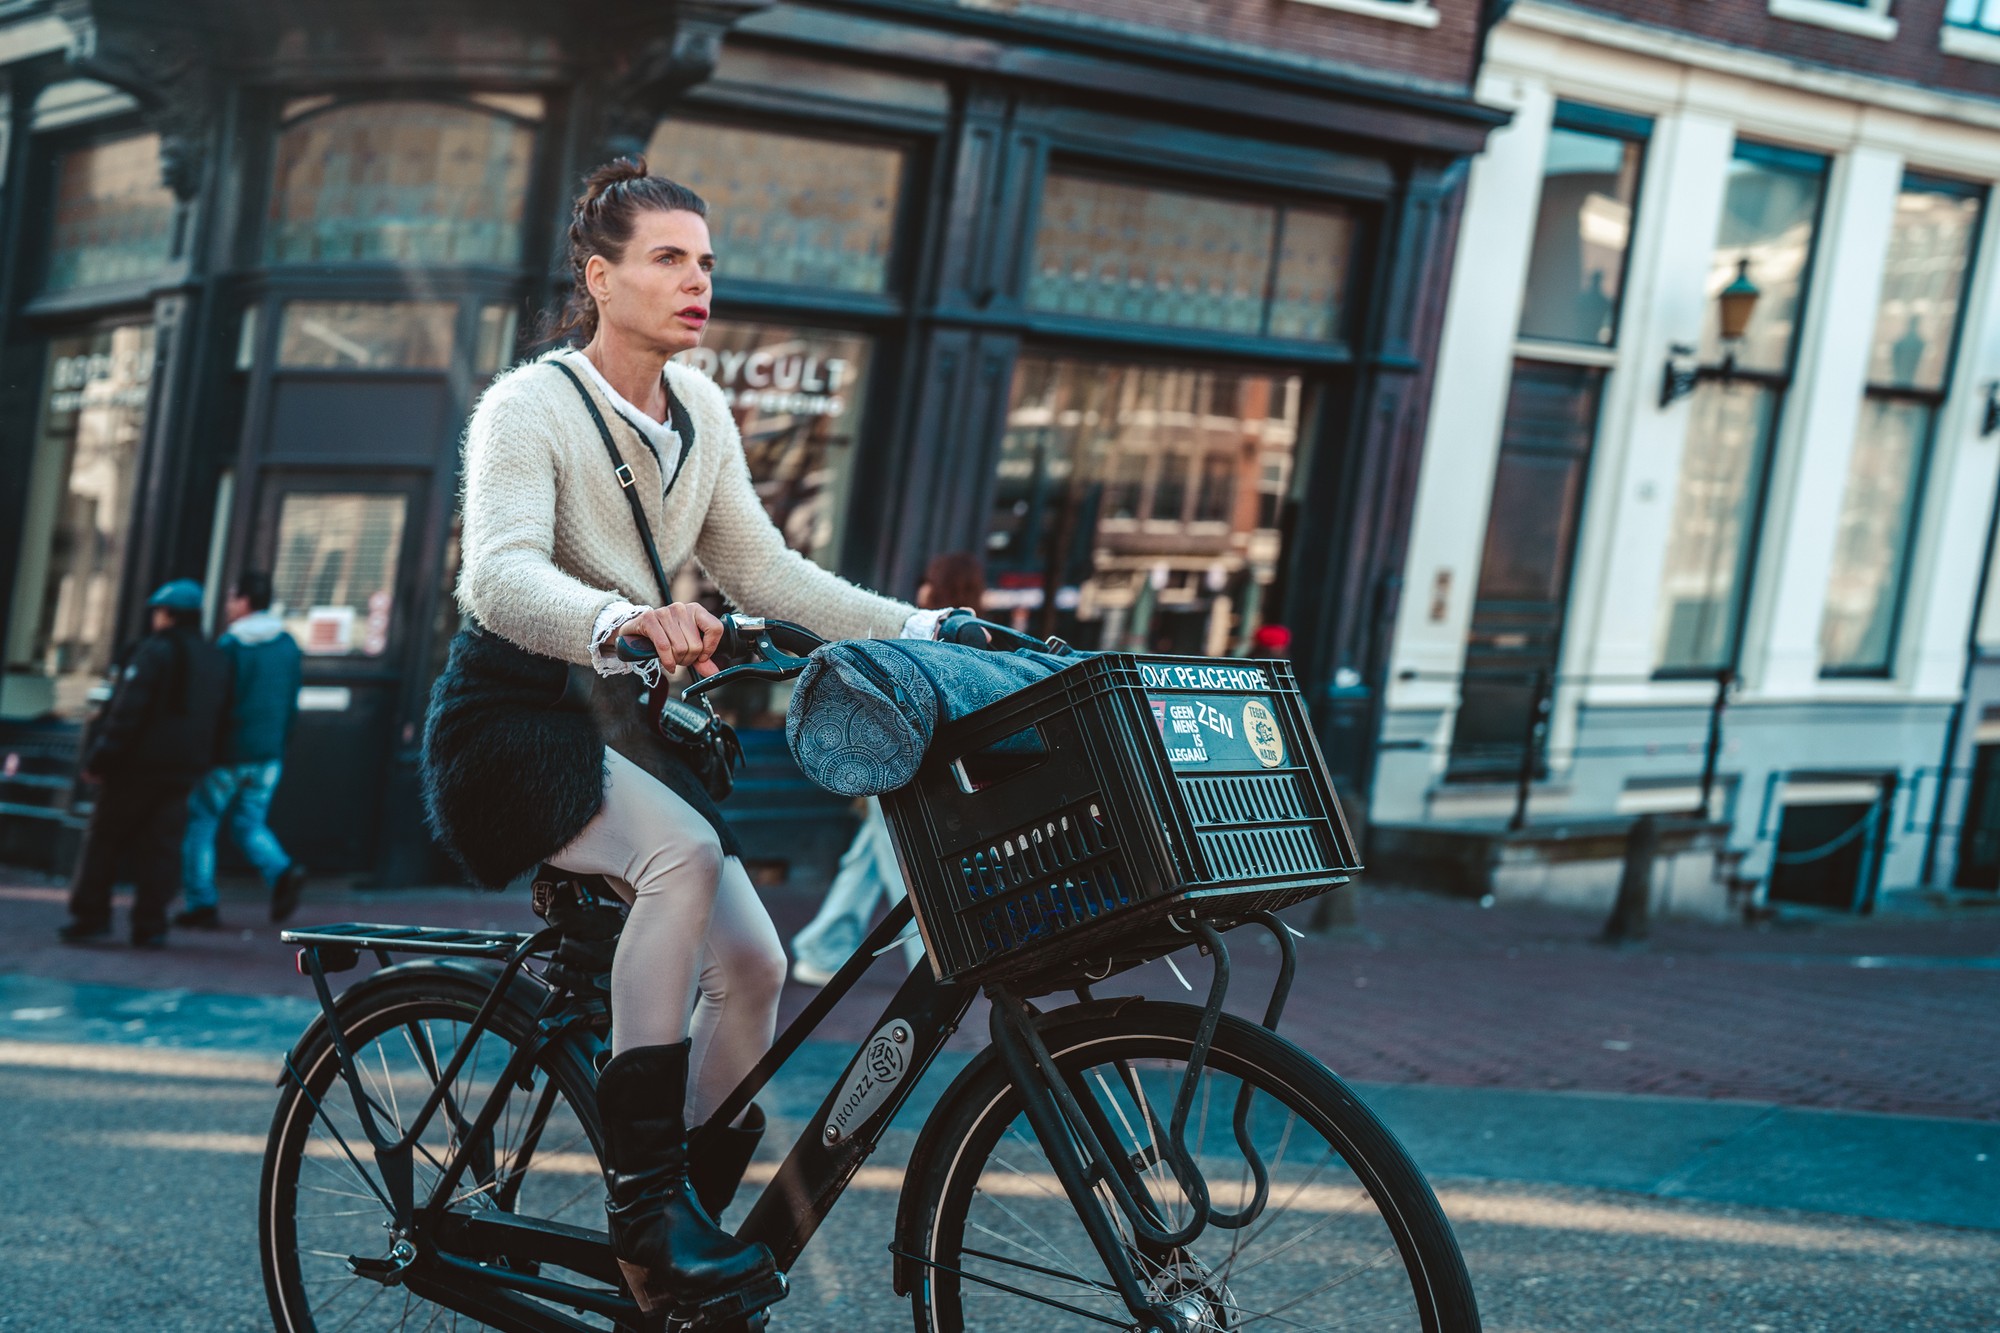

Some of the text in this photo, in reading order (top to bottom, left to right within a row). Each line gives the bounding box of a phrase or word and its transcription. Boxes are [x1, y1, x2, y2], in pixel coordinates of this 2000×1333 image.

[688, 346, 848, 392] DYCULT
[1142, 665, 1179, 688] OVE
[1170, 705, 1196, 719] GEEN
[1248, 706, 1267, 720] TEGEN
[1172, 719, 1199, 734] MENS
[1195, 700, 1234, 739] ZEN
[1192, 733, 1203, 747] IS
[1166, 747, 1208, 761] LLEGAAL!
[1259, 748, 1277, 761] NAZIS
[836, 1075, 873, 1127] BOOZZ
